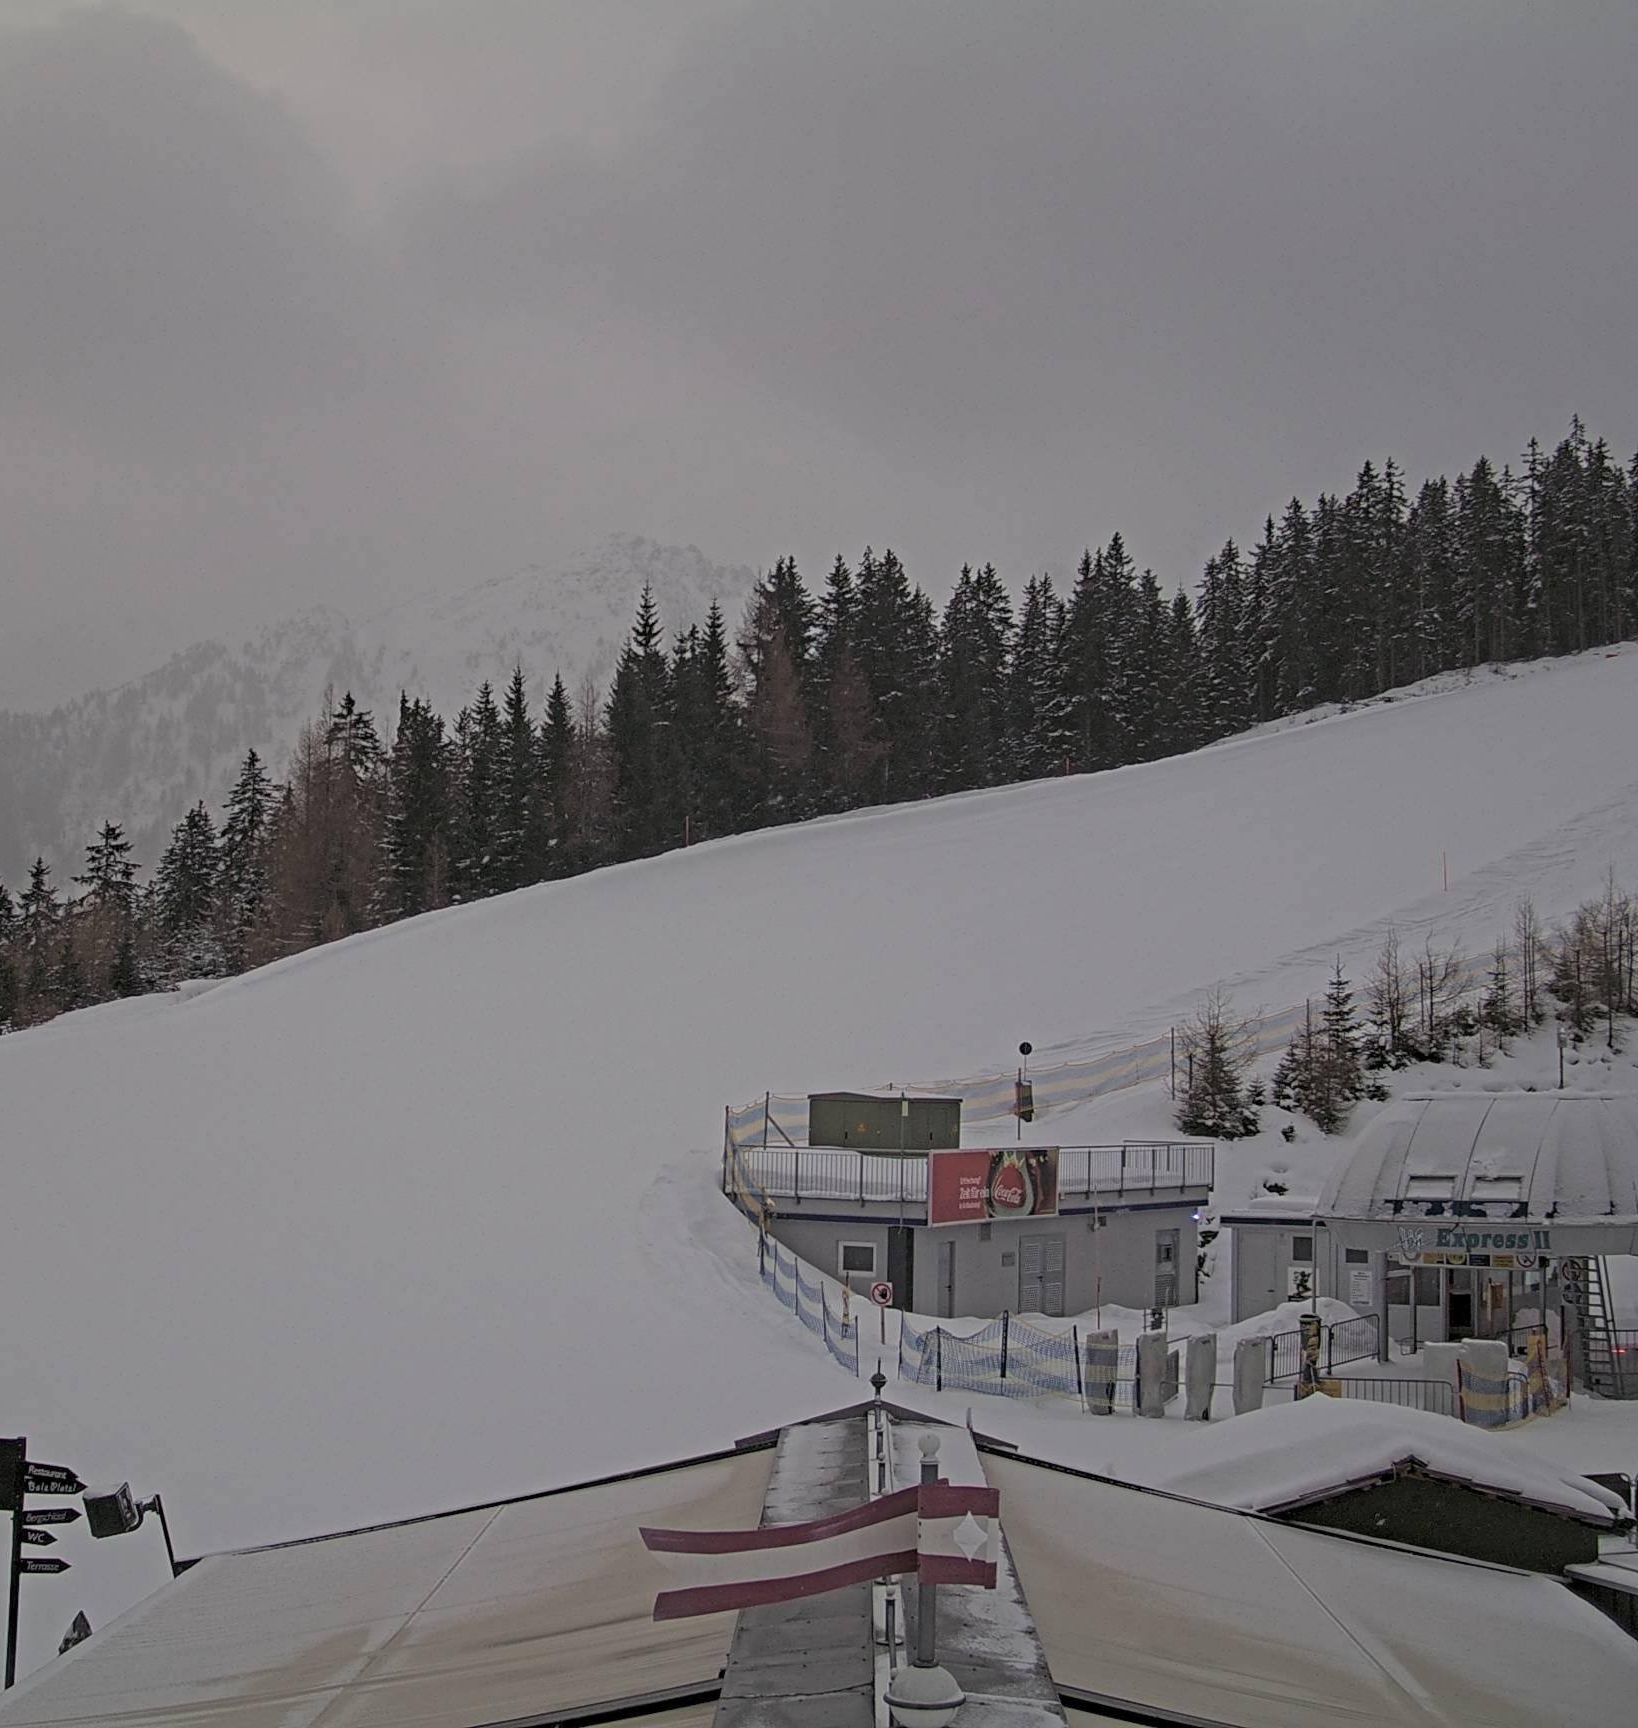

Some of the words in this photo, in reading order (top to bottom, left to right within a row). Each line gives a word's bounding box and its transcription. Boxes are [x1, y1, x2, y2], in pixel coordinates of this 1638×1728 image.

[1436, 1228, 1529, 1249] Express
[27, 1531, 45, 1543] WC
[26, 1561, 60, 1571] Terrasse
